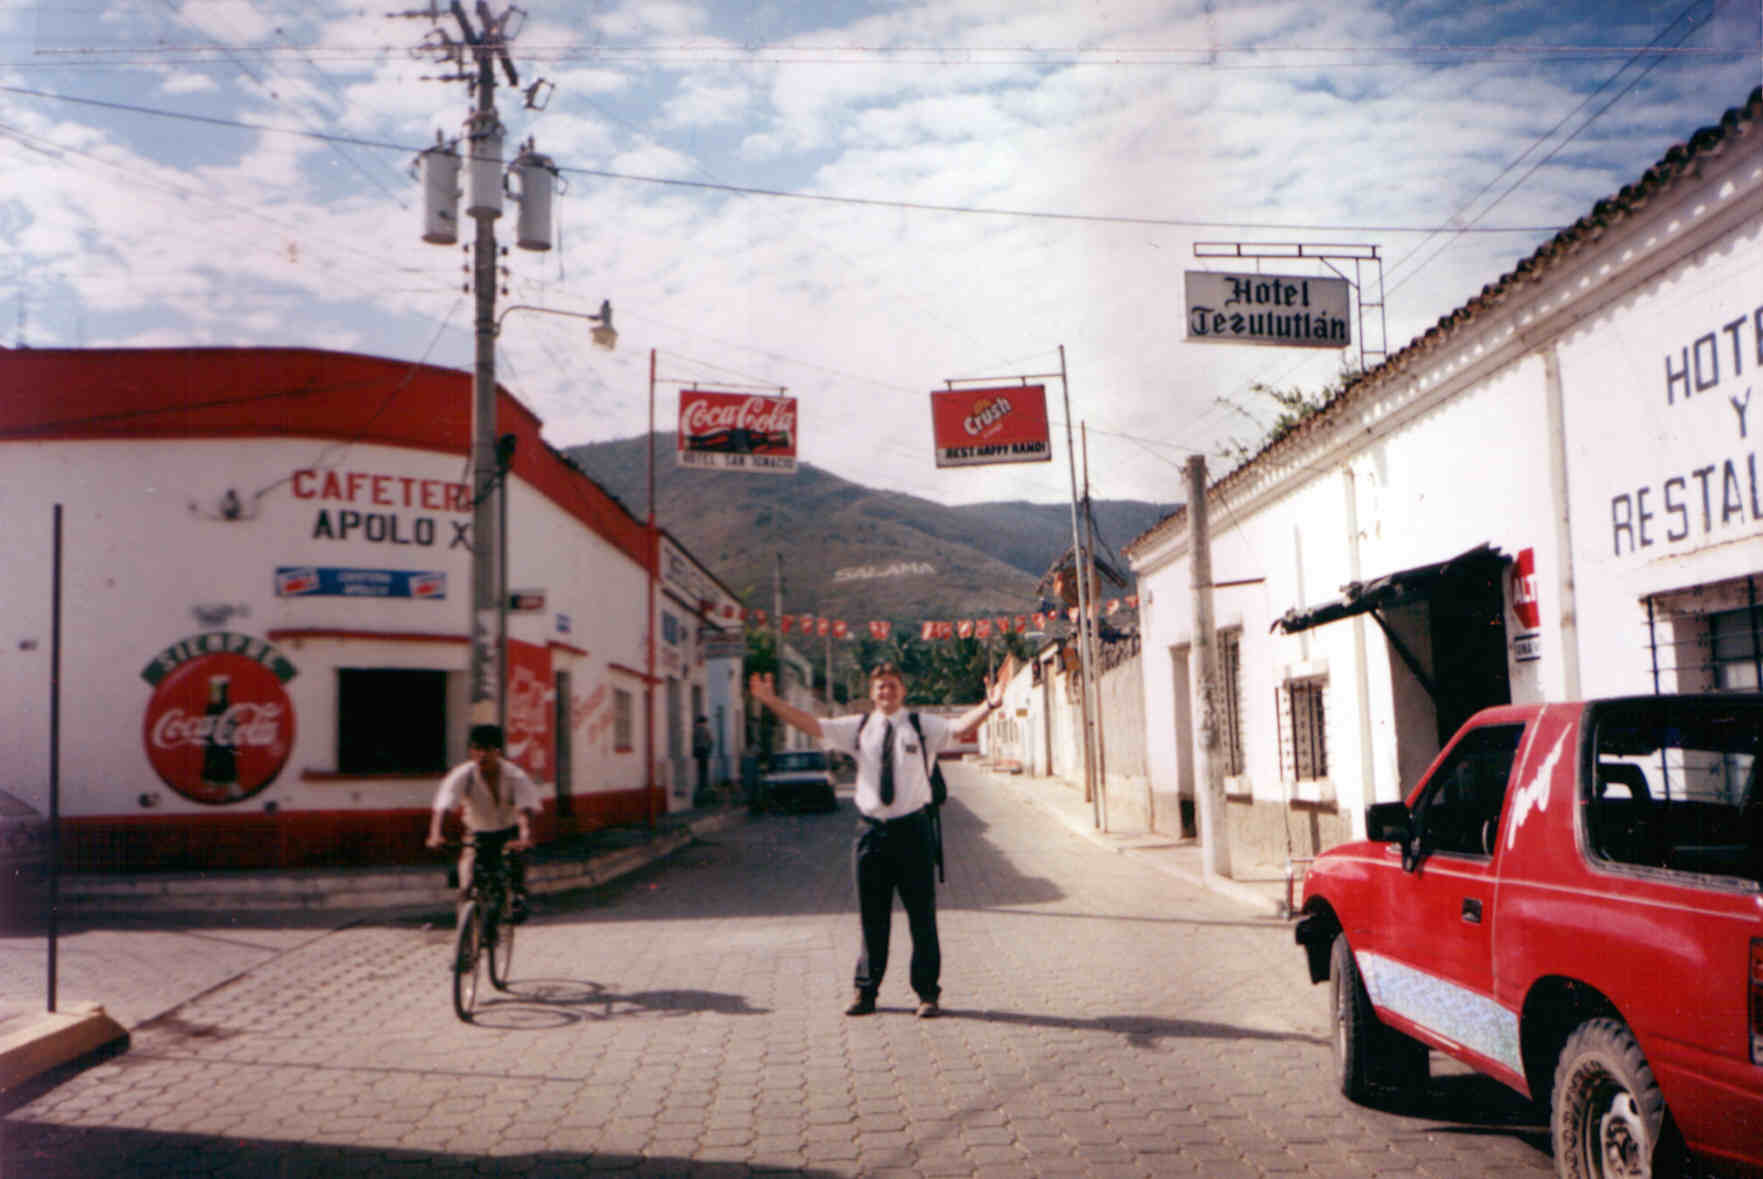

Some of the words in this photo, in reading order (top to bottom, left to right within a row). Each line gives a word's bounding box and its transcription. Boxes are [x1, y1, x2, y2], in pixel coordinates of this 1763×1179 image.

[1224, 277, 1310, 307] Hotel
[963, 396, 1012, 435] Crush
[1729, 386, 1751, 438] Y
[312, 508, 436, 547] APOLO
